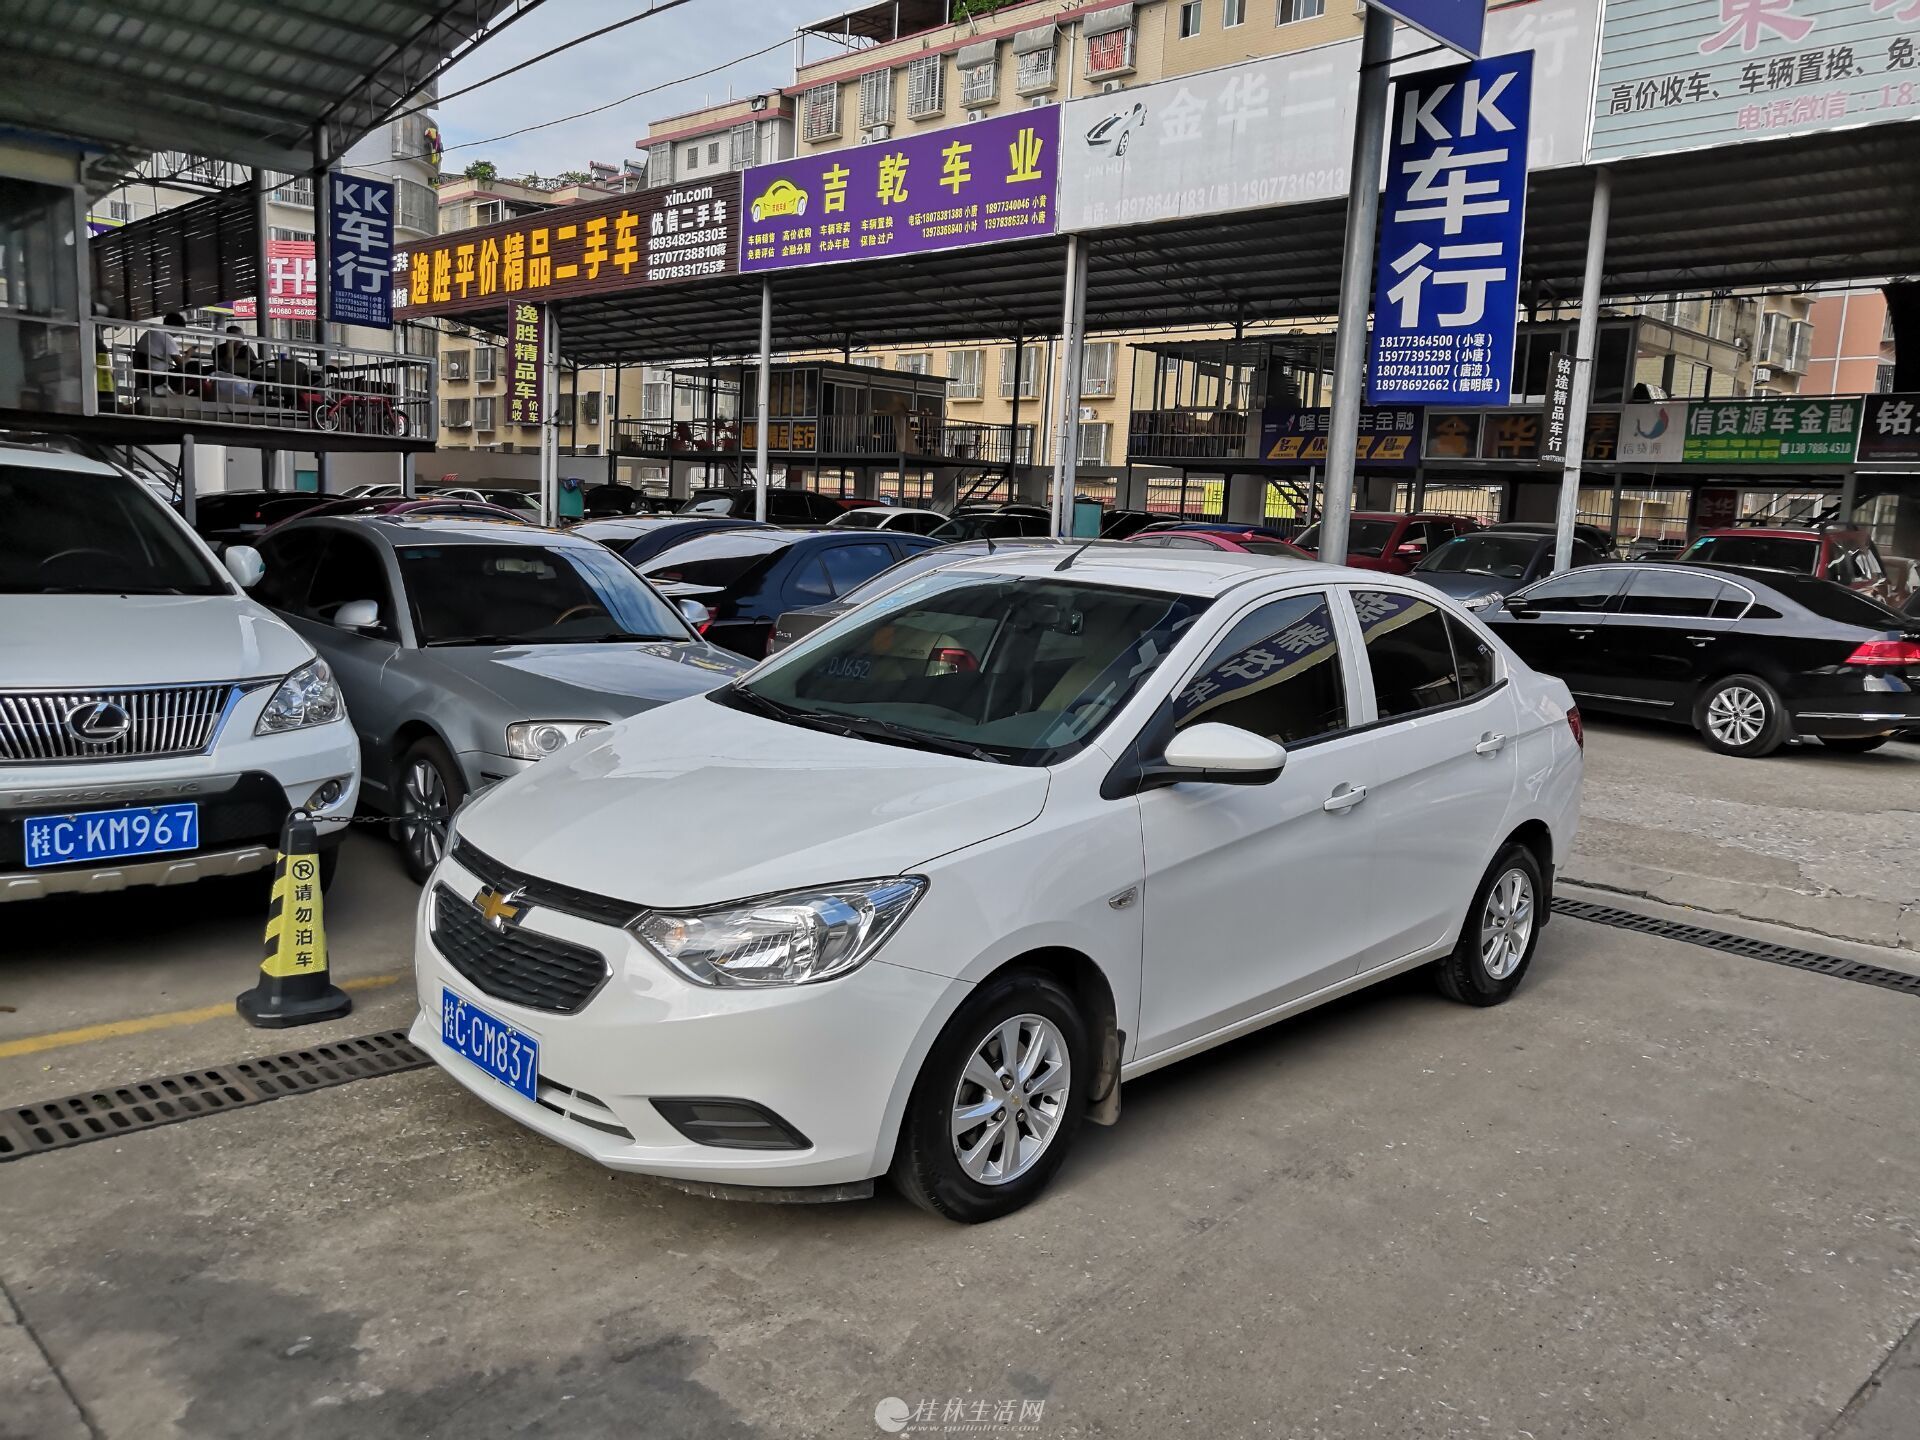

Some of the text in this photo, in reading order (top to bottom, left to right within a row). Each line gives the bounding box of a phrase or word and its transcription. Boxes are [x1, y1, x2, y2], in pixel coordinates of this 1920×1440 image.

[1400, 72, 1518, 145] KK
[335, 180, 389, 214] KK
[651, 200, 727, 236] 优信二手车
[665, 187, 712, 207] xin.com
[336, 211, 389, 293] 车行
[411, 209, 639, 305] 逸胜平价精品二手车
[1387, 147, 1509, 328] 车行
[515, 305, 539, 399] 逸胜精品车
[1299, 411, 1415, 432] 蜂鸟车金融
[1548, 358, 1571, 451] 铭途精品车行
[1690, 403, 1854, 435] 信贷源车金融
[1876, 400, 1920, 435] 铭
[295, 884, 313, 967] 请勿泊车
